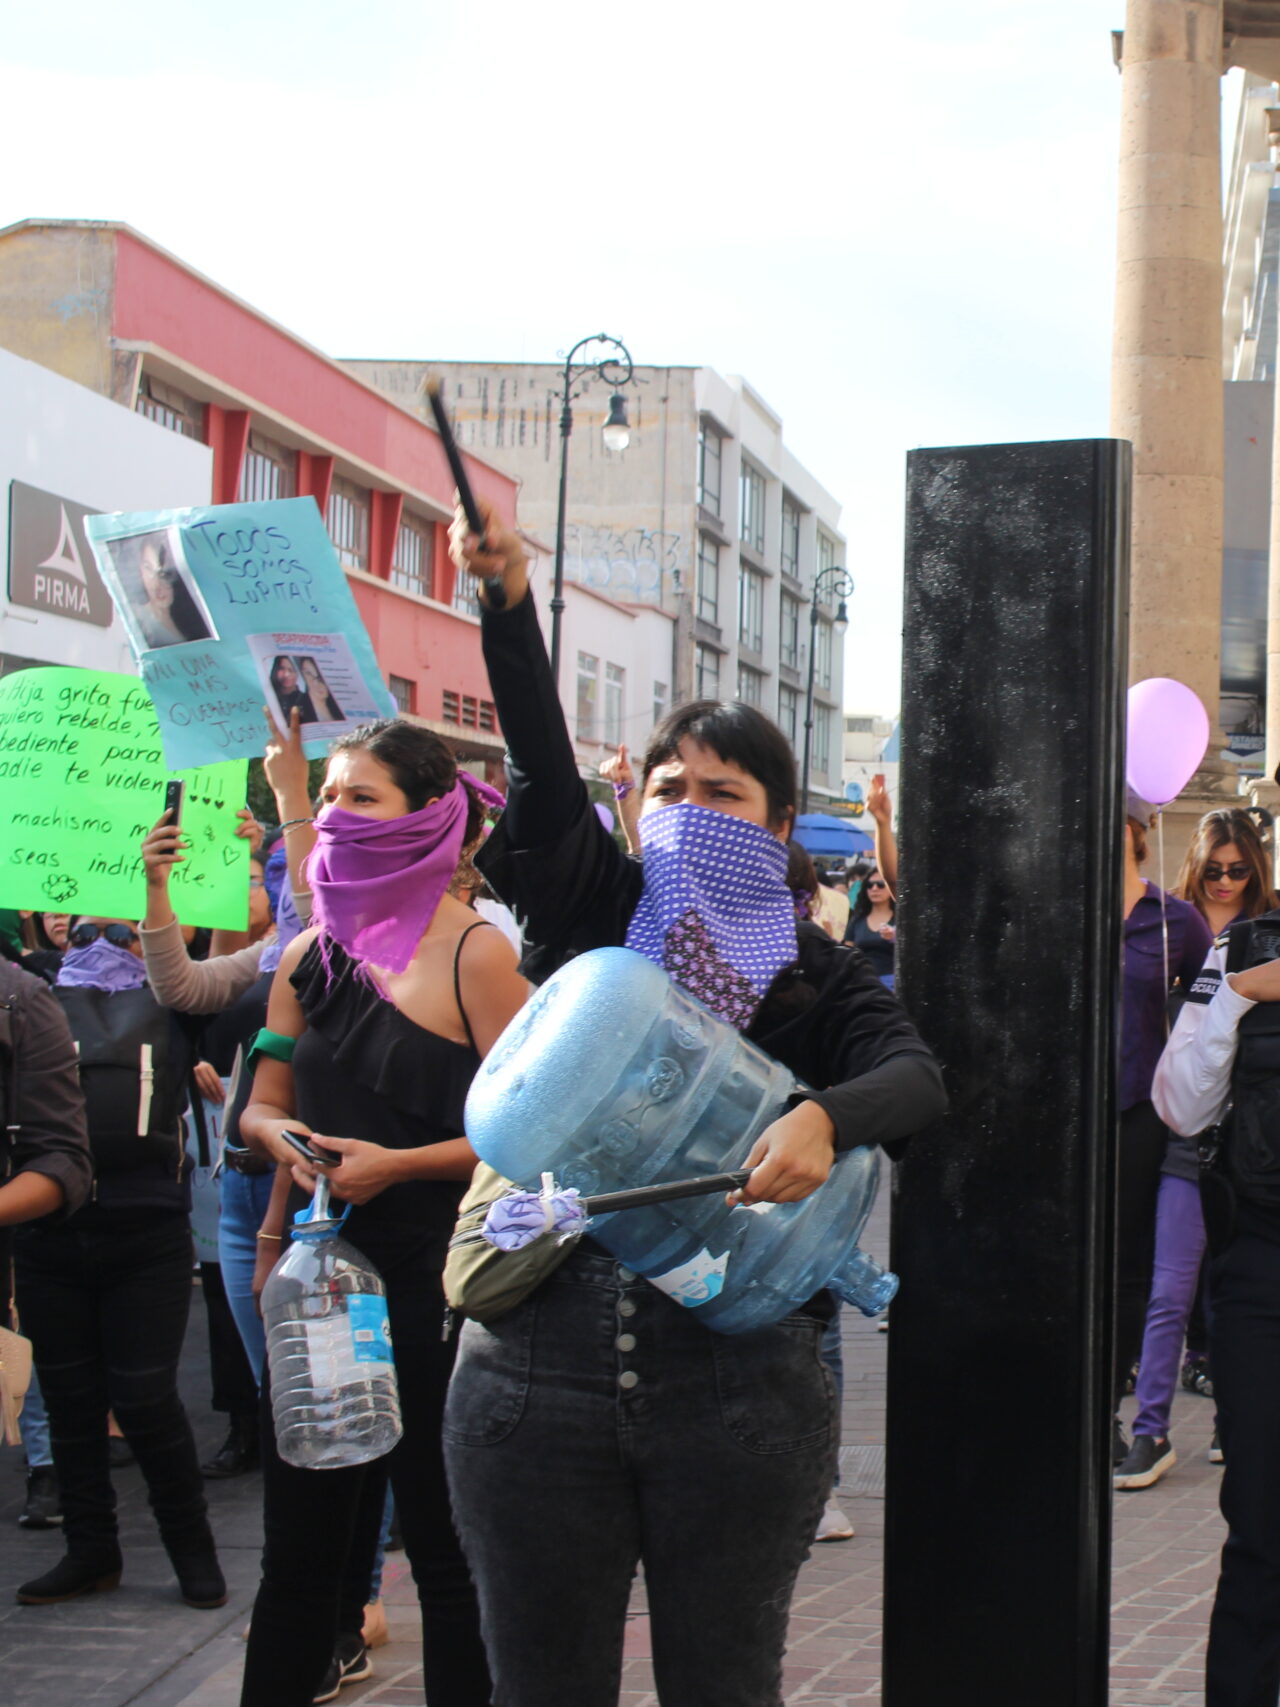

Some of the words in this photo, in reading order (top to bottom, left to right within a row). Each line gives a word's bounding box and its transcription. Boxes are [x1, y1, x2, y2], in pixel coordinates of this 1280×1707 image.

[34, 573, 91, 615] PIRMA
[56, 683, 111, 712] grita
[56, 707, 141, 739] rebelde,
[100, 745, 162, 767] para
[64, 760, 90, 786] te
[11, 805, 113, 834] machismo
